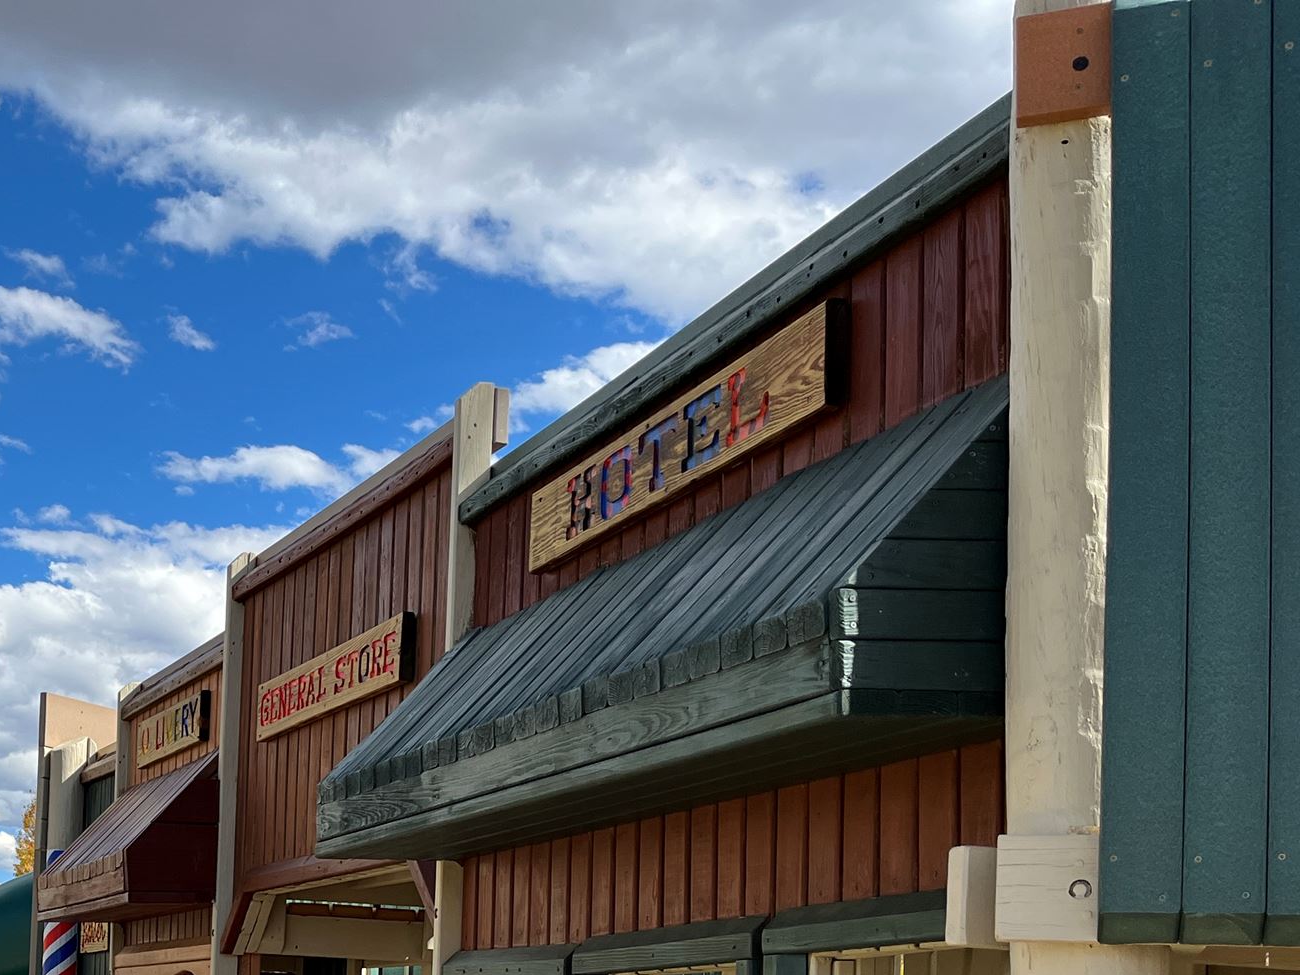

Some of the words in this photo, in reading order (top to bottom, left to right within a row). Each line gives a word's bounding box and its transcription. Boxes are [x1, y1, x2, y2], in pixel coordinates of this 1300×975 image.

[565, 366, 770, 542] HOTEL
[155, 697, 199, 751] LIVERY
[259, 665, 327, 727] GENERAL
[333, 630, 397, 696] STORE
